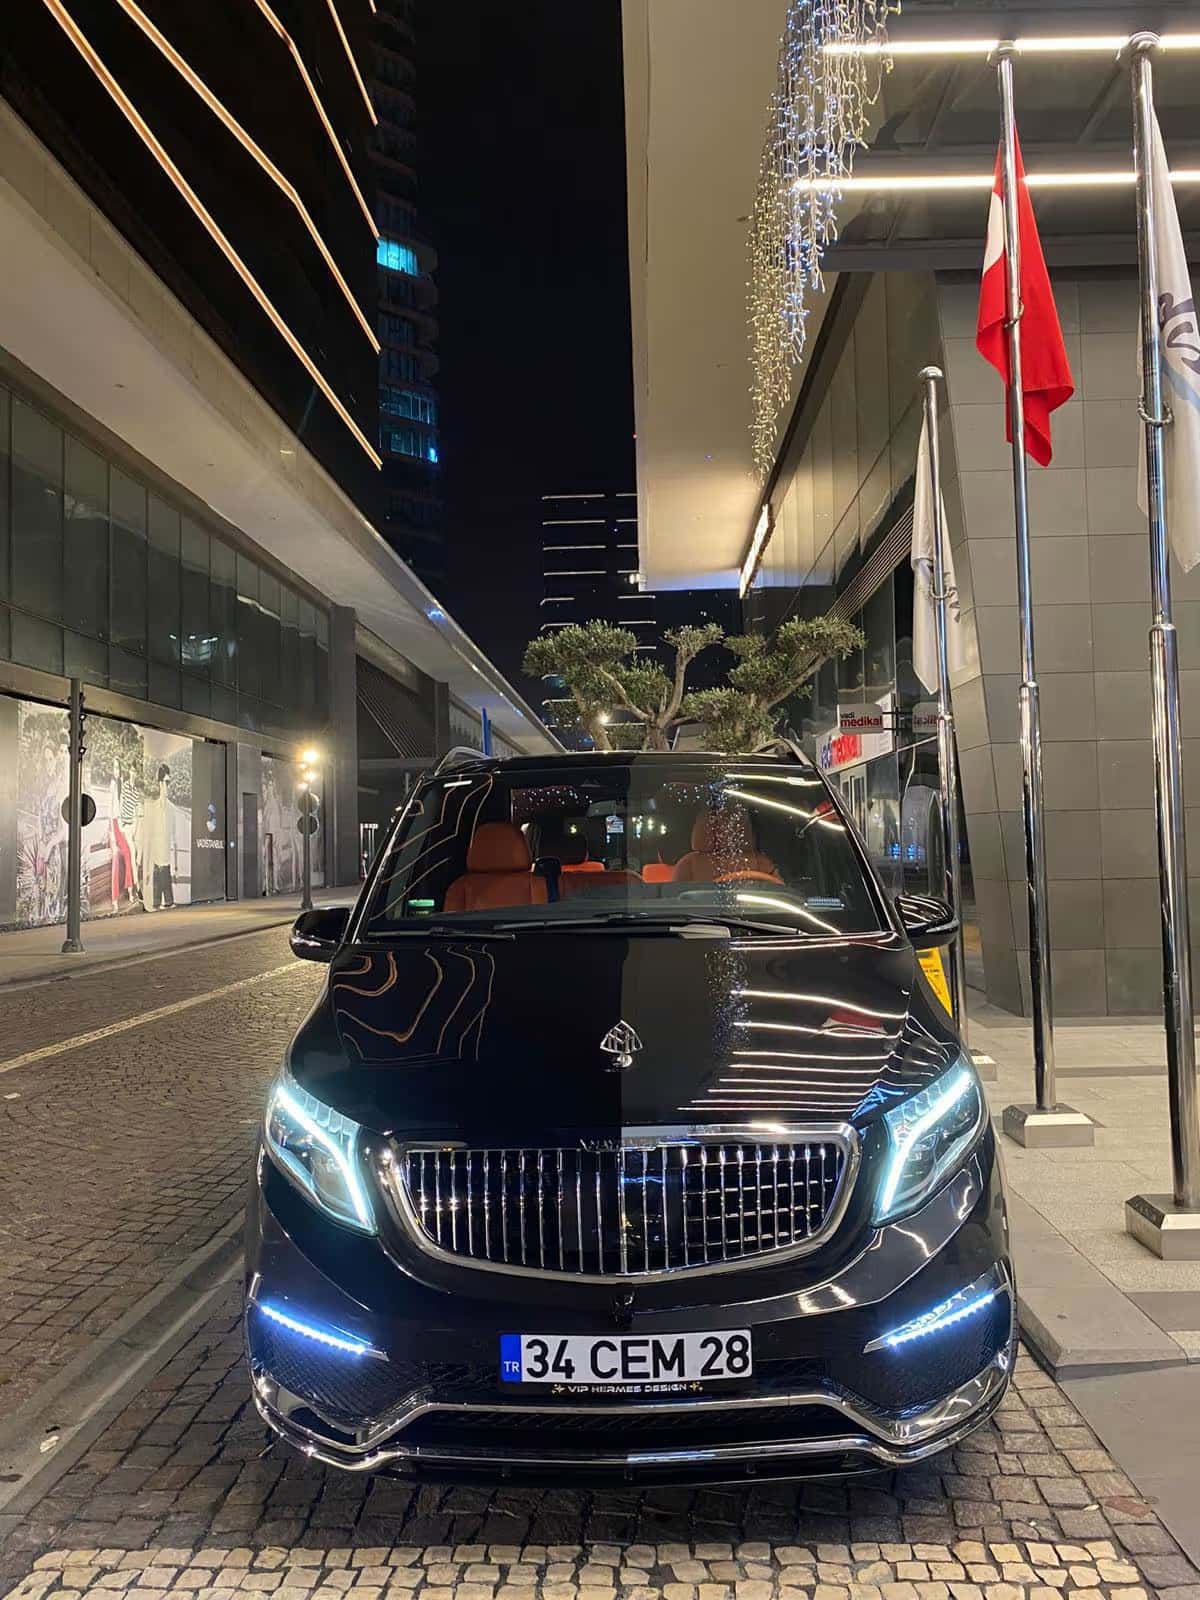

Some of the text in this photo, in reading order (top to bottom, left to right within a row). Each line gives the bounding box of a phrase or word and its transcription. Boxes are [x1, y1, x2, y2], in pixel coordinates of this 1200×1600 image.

[841, 715, 882, 727] medikal
[503, 1335, 750, 1380] TR 34 CEM 28
[567, 1383, 687, 1394] VIP HERMES DESIGN
